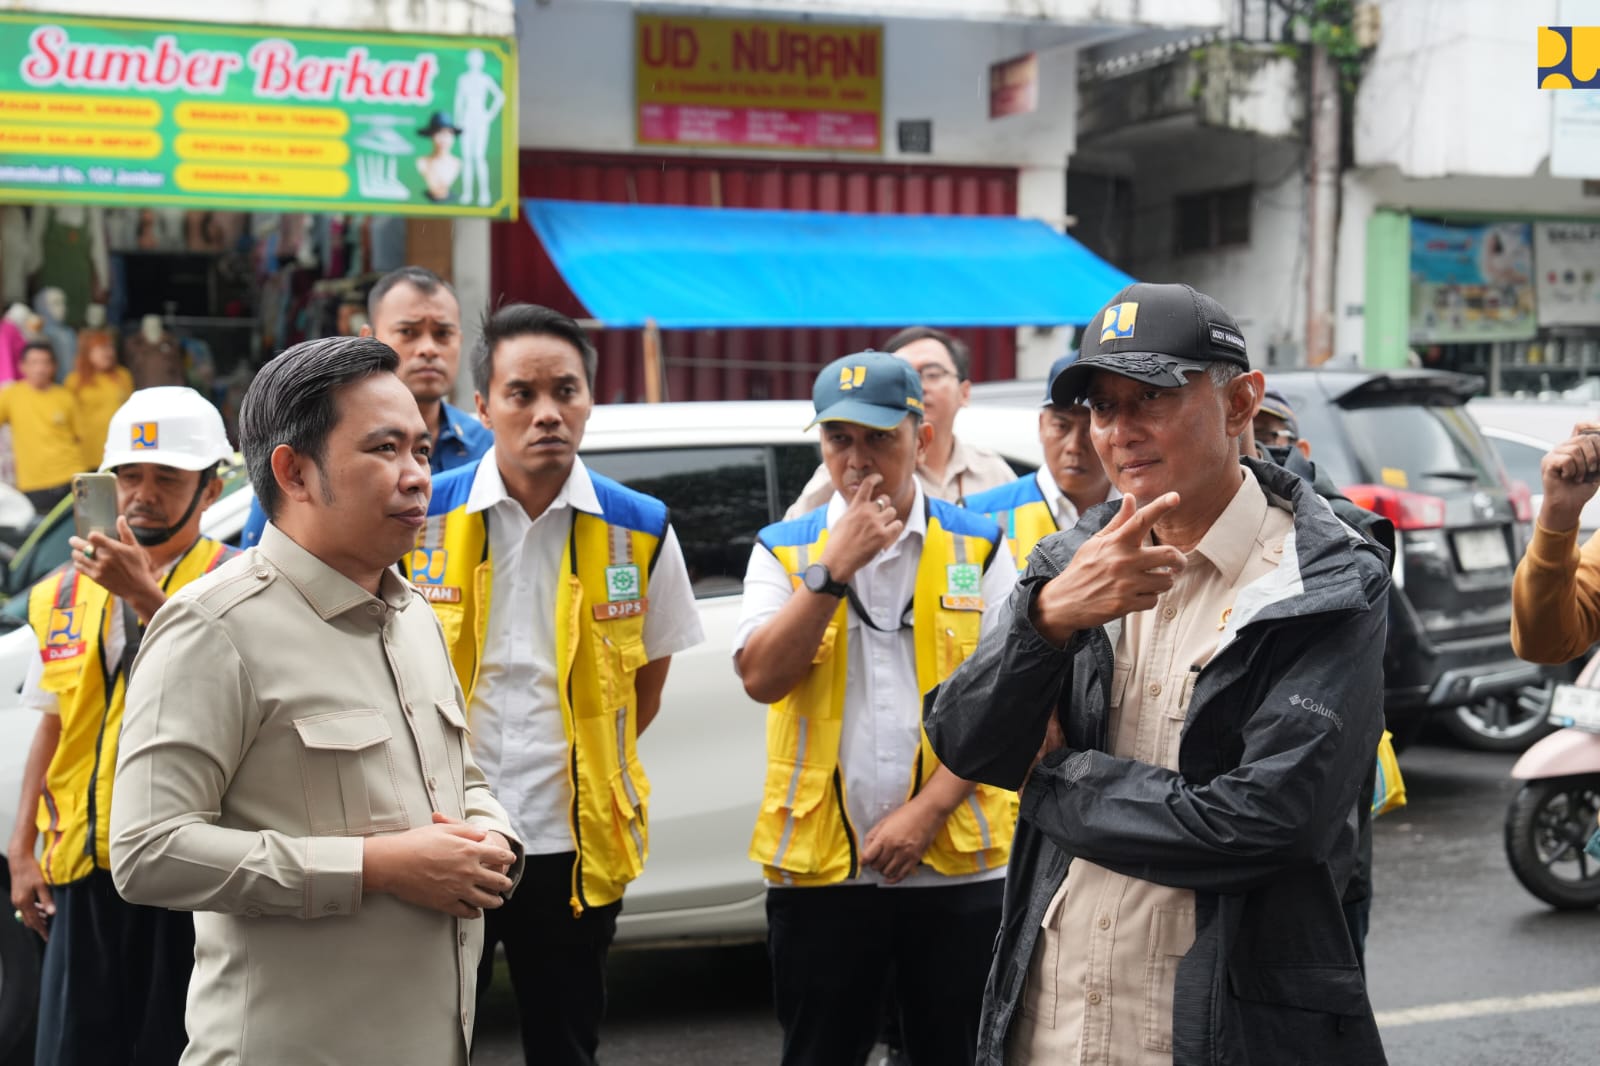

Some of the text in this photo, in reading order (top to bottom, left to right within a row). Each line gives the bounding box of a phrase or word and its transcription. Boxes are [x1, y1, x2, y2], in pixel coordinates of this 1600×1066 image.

[21, 25, 438, 104] Sumber Berkat
[641, 23, 699, 70] UD
[731, 26, 878, 80] NURANI
[607, 601, 641, 617] DJPS
